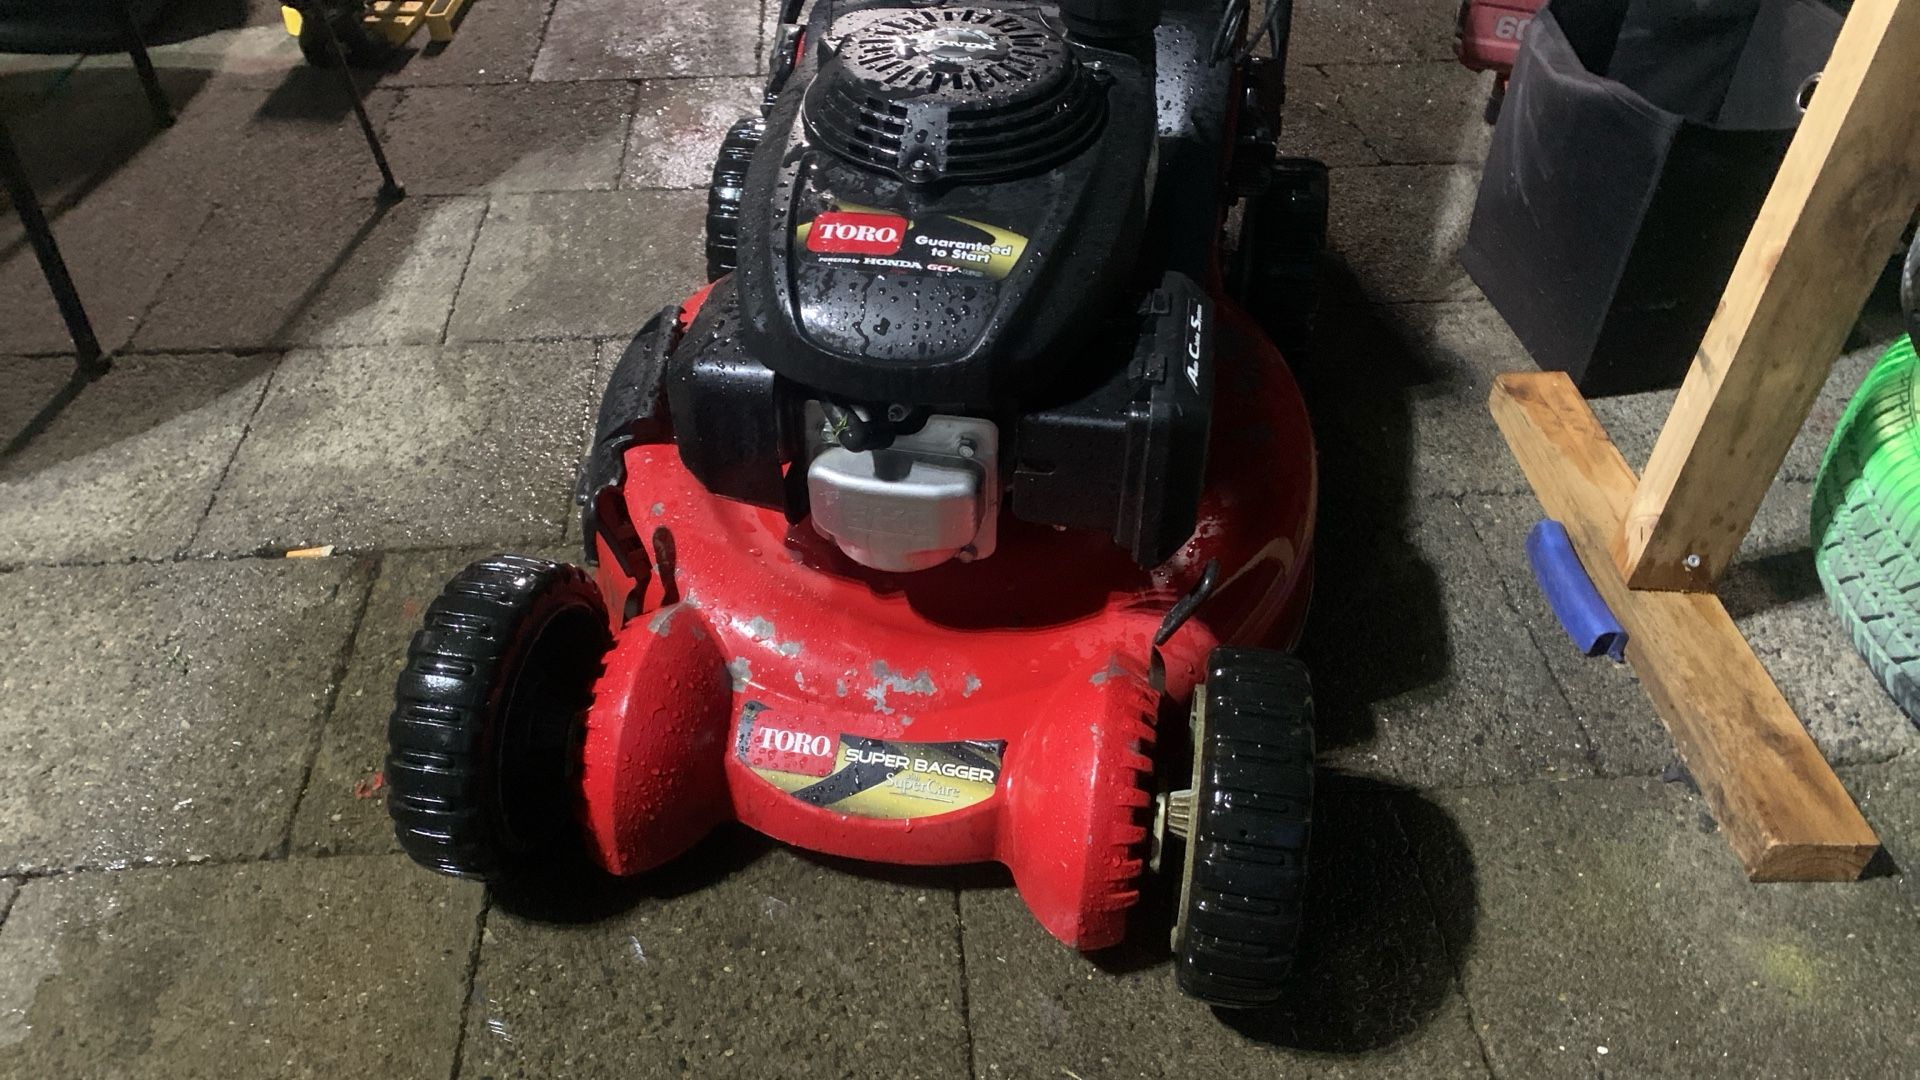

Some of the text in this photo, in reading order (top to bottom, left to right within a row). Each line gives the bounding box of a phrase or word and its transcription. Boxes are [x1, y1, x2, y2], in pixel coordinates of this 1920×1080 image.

[819, 222, 897, 243] TORO
[915, 235, 1012, 256] Guaranteed
[931, 247, 990, 263] to Start
[863, 257, 922, 269] HONDA
[759, 726, 831, 757] TORO
[845, 748, 995, 783] SUPER BAGGER
[886, 772, 961, 798] SuperCare
